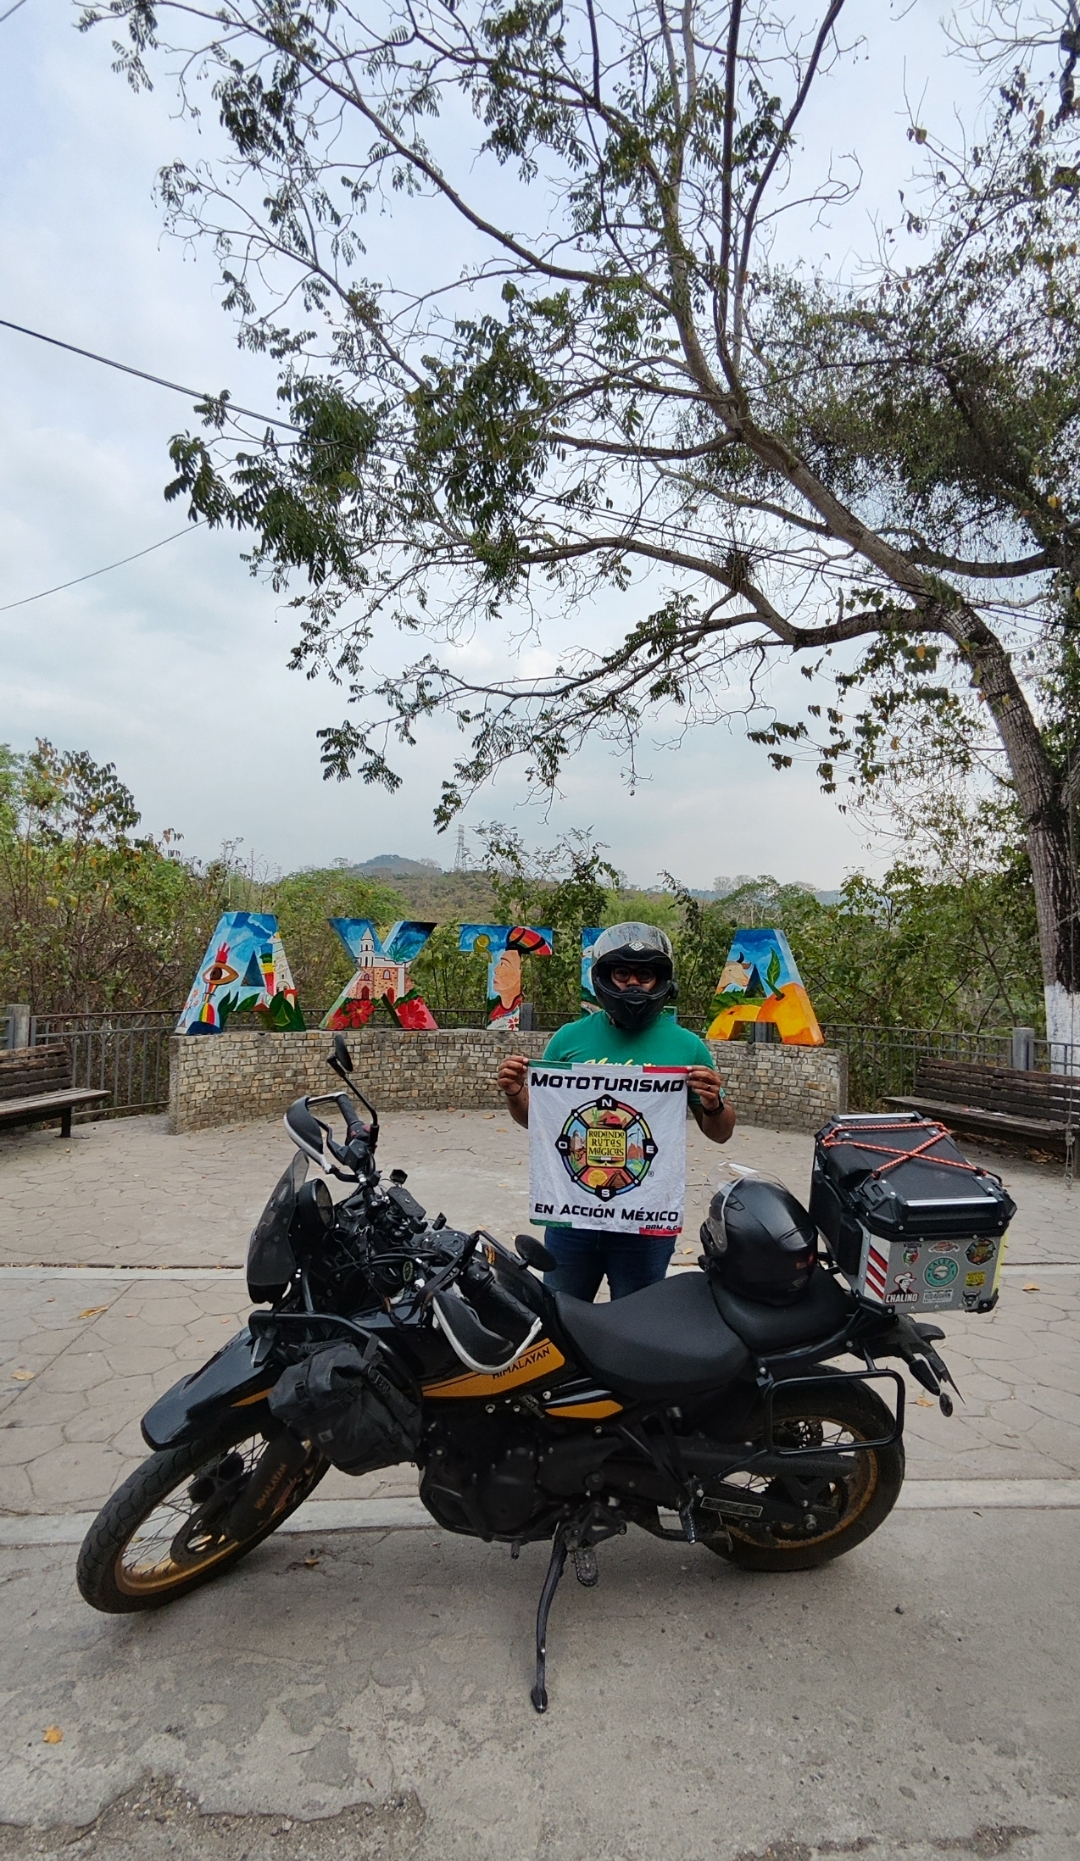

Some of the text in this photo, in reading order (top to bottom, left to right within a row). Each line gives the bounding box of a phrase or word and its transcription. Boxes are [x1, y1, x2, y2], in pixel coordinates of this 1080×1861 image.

[531, 1072, 684, 1092] MOTOTURISMO
[601, 1098, 613, 1107] N
[646, 1145, 655, 1154] E
[601, 1188, 611, 1198] S
[534, 1203, 679, 1222] EN ACCIÓN MÉXICO
[885, 1293, 919, 1303] CHALINO
[493, 1347, 550, 1379] HIMALAYAN
